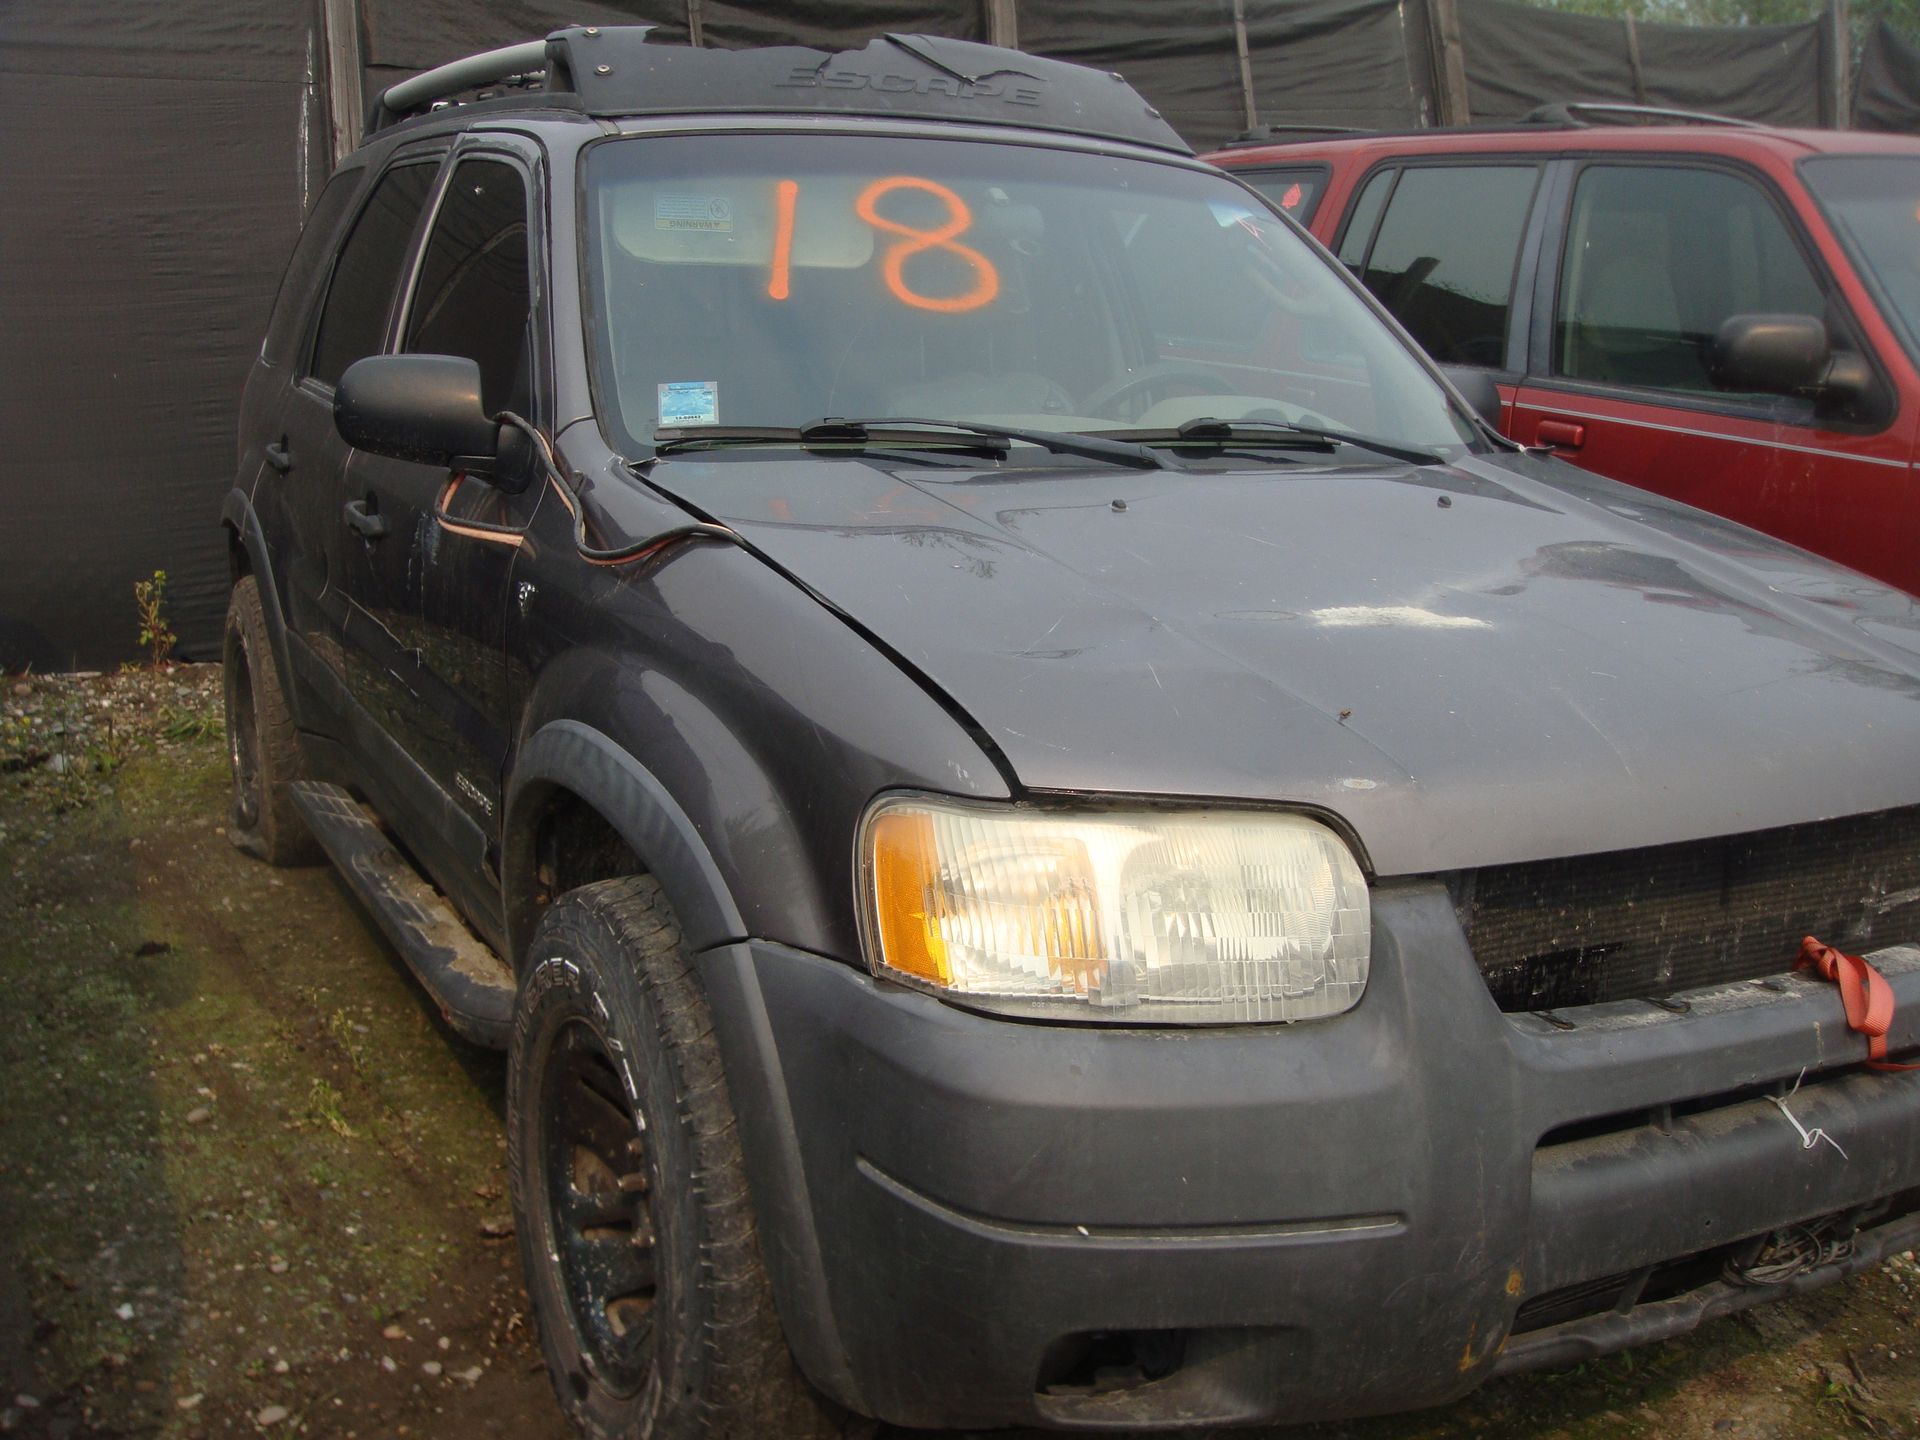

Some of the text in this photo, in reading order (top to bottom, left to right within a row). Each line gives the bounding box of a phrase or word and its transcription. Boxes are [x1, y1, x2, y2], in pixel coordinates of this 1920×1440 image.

[774, 66, 1042, 107] ESCAPE
[669, 219, 713, 229] WARNING
[766, 175, 1000, 314] 18
